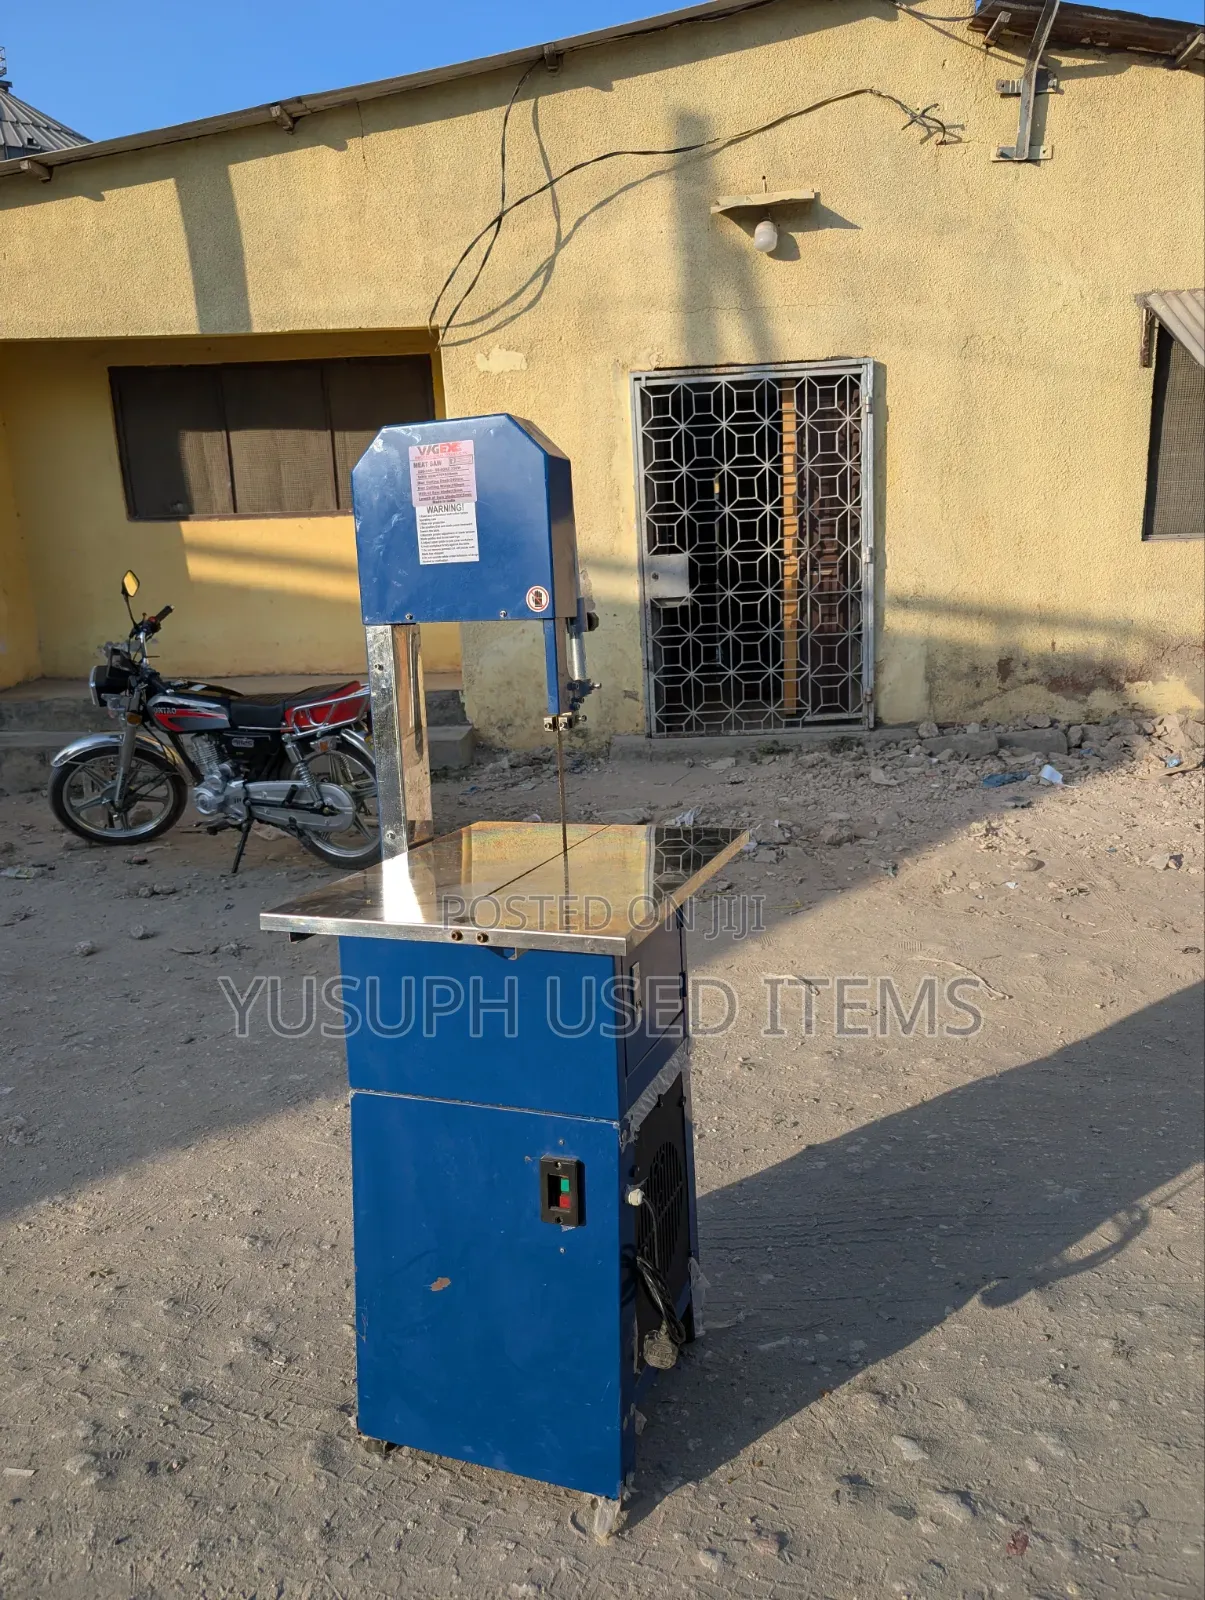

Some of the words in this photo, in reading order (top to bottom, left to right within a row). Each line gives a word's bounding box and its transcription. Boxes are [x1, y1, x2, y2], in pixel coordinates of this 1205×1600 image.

[413, 461, 429, 469] MEAT
[429, 459, 442, 468] SAW
[426, 503, 464, 515] WARNING!
